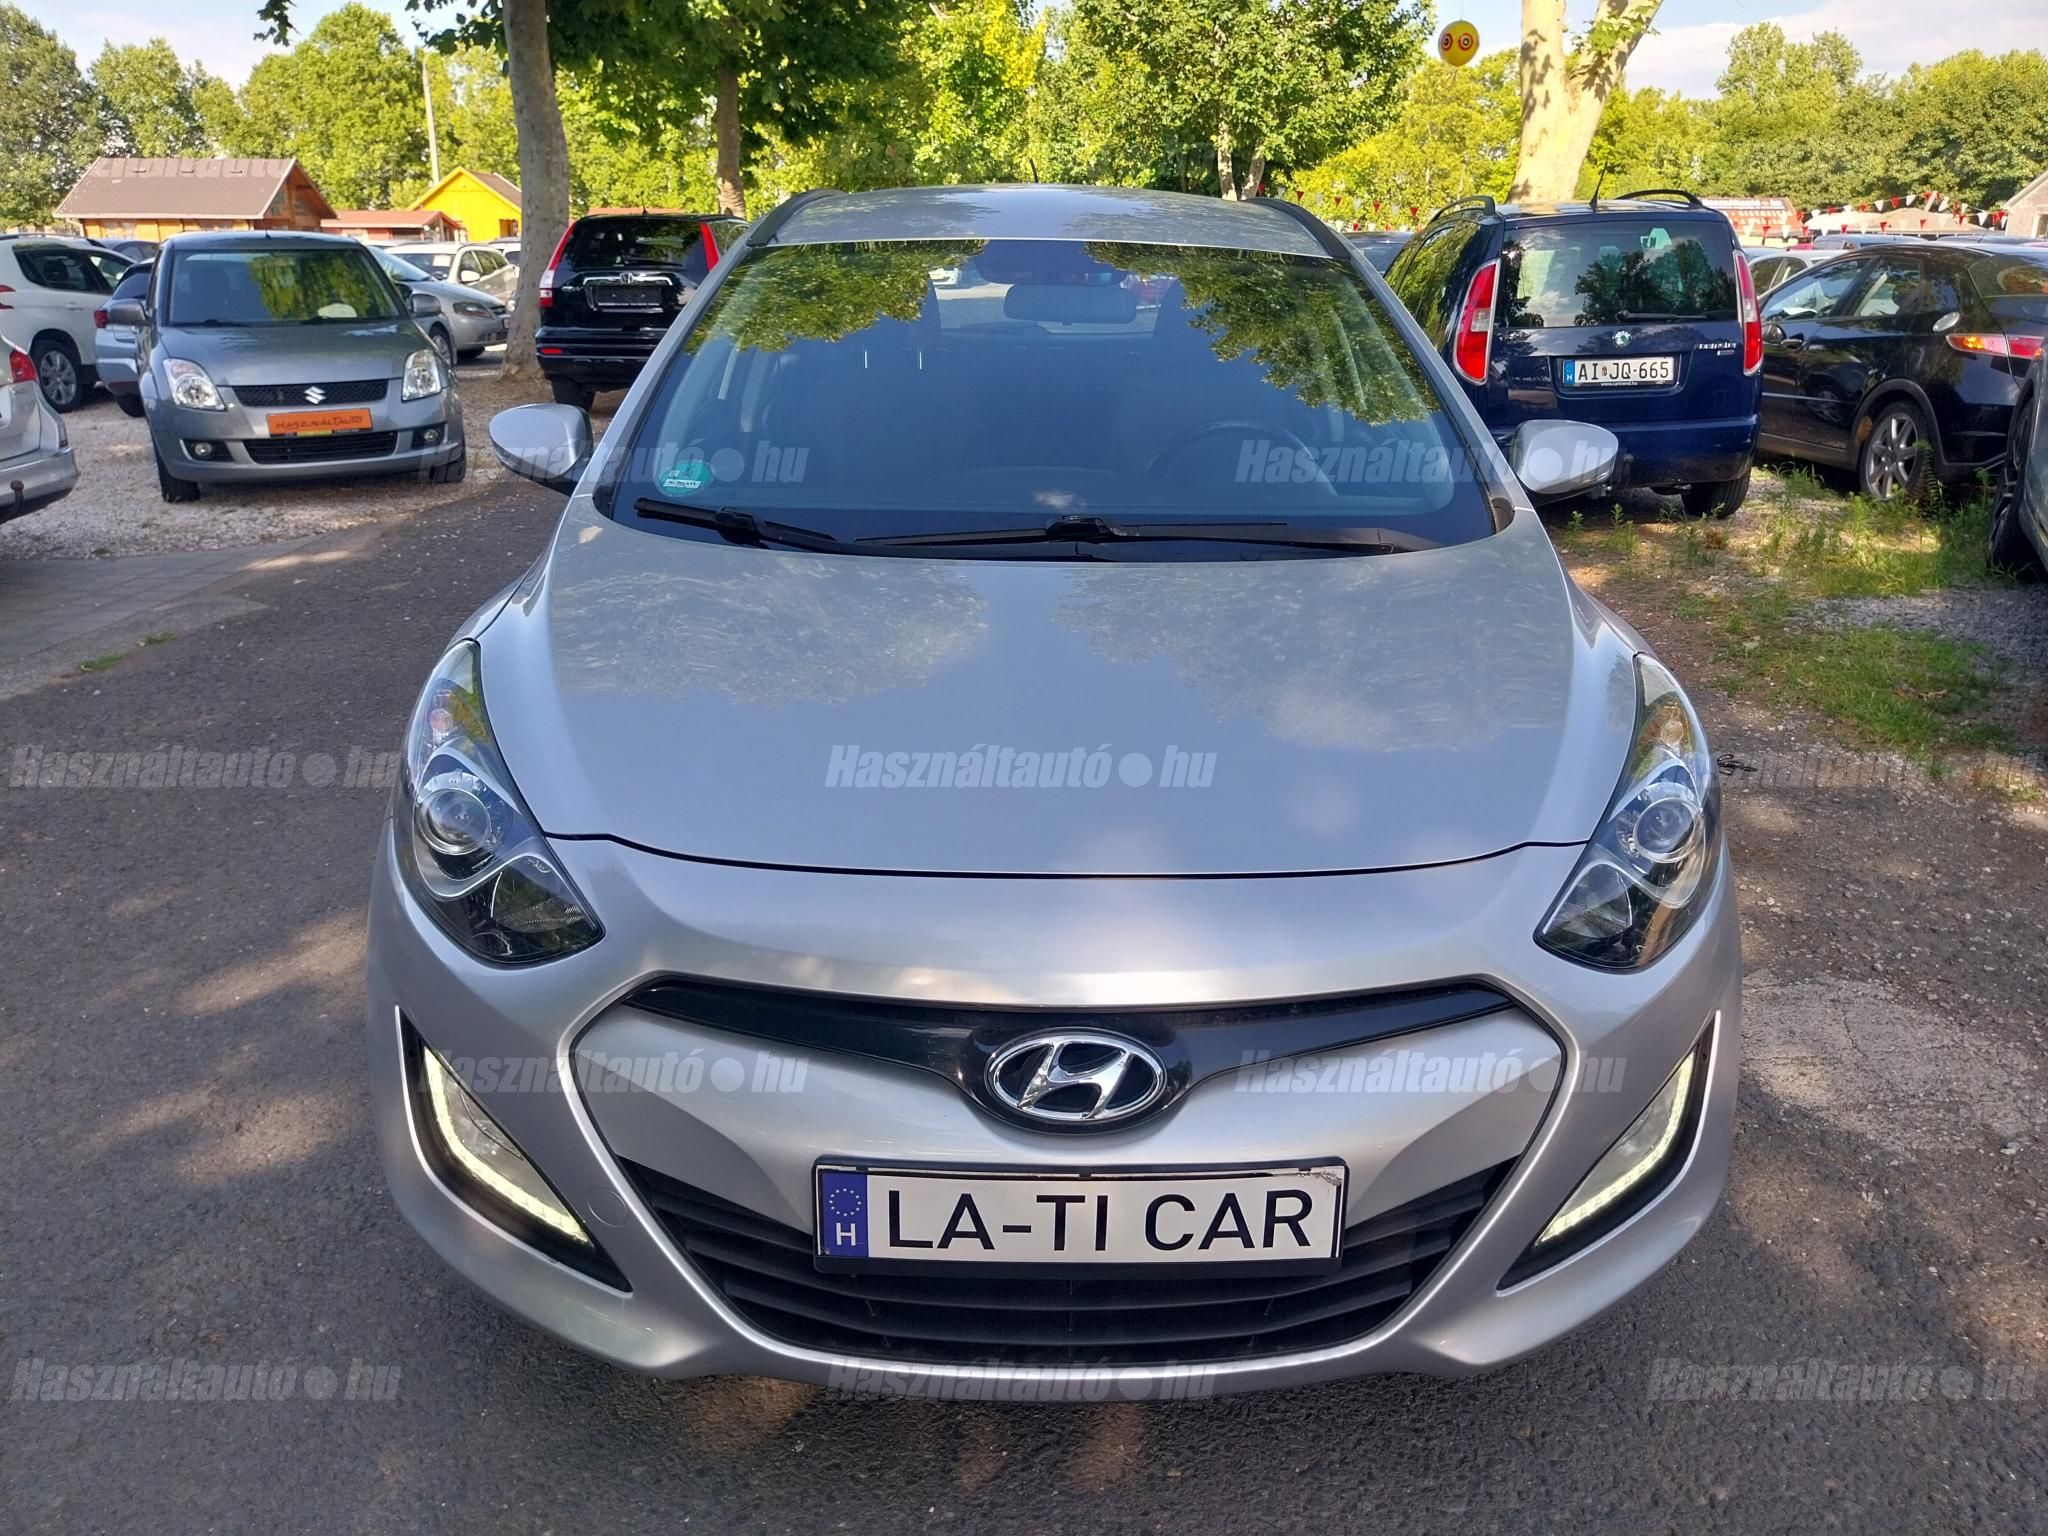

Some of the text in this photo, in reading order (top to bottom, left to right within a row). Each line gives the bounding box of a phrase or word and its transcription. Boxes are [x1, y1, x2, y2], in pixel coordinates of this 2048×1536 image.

[1609, 361, 1669, 380] JQ-665
[888, 1188, 1313, 1251] LA-TI CAR
[835, 1222, 857, 1246] H
